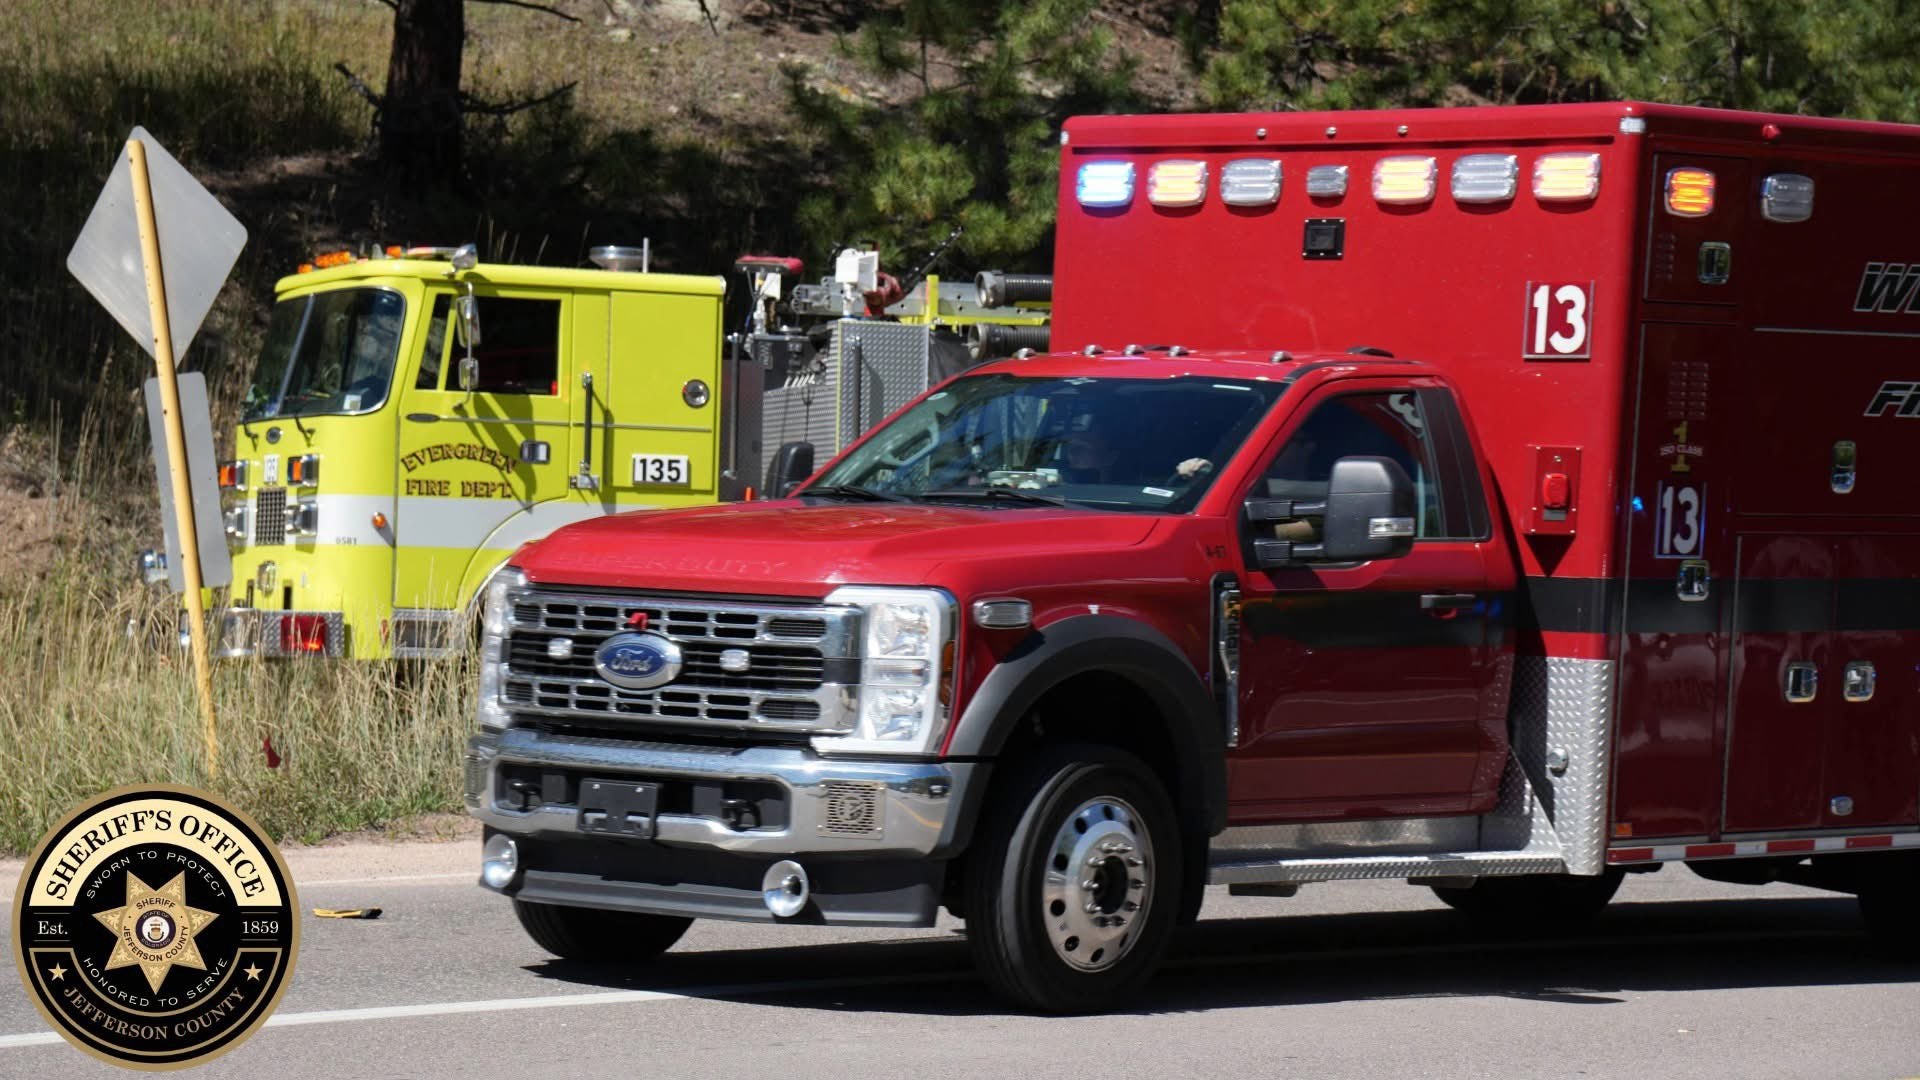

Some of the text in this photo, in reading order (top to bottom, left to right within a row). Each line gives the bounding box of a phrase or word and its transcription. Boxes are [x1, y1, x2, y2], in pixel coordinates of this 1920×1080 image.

[1533, 283, 1587, 354] 13
[401, 442, 517, 474] EVERGREEN
[639, 458, 682, 482] 135
[406, 479, 451, 496] FIRE
[1662, 485, 1699, 554] 13
[610, 647, 654, 672] Ford
